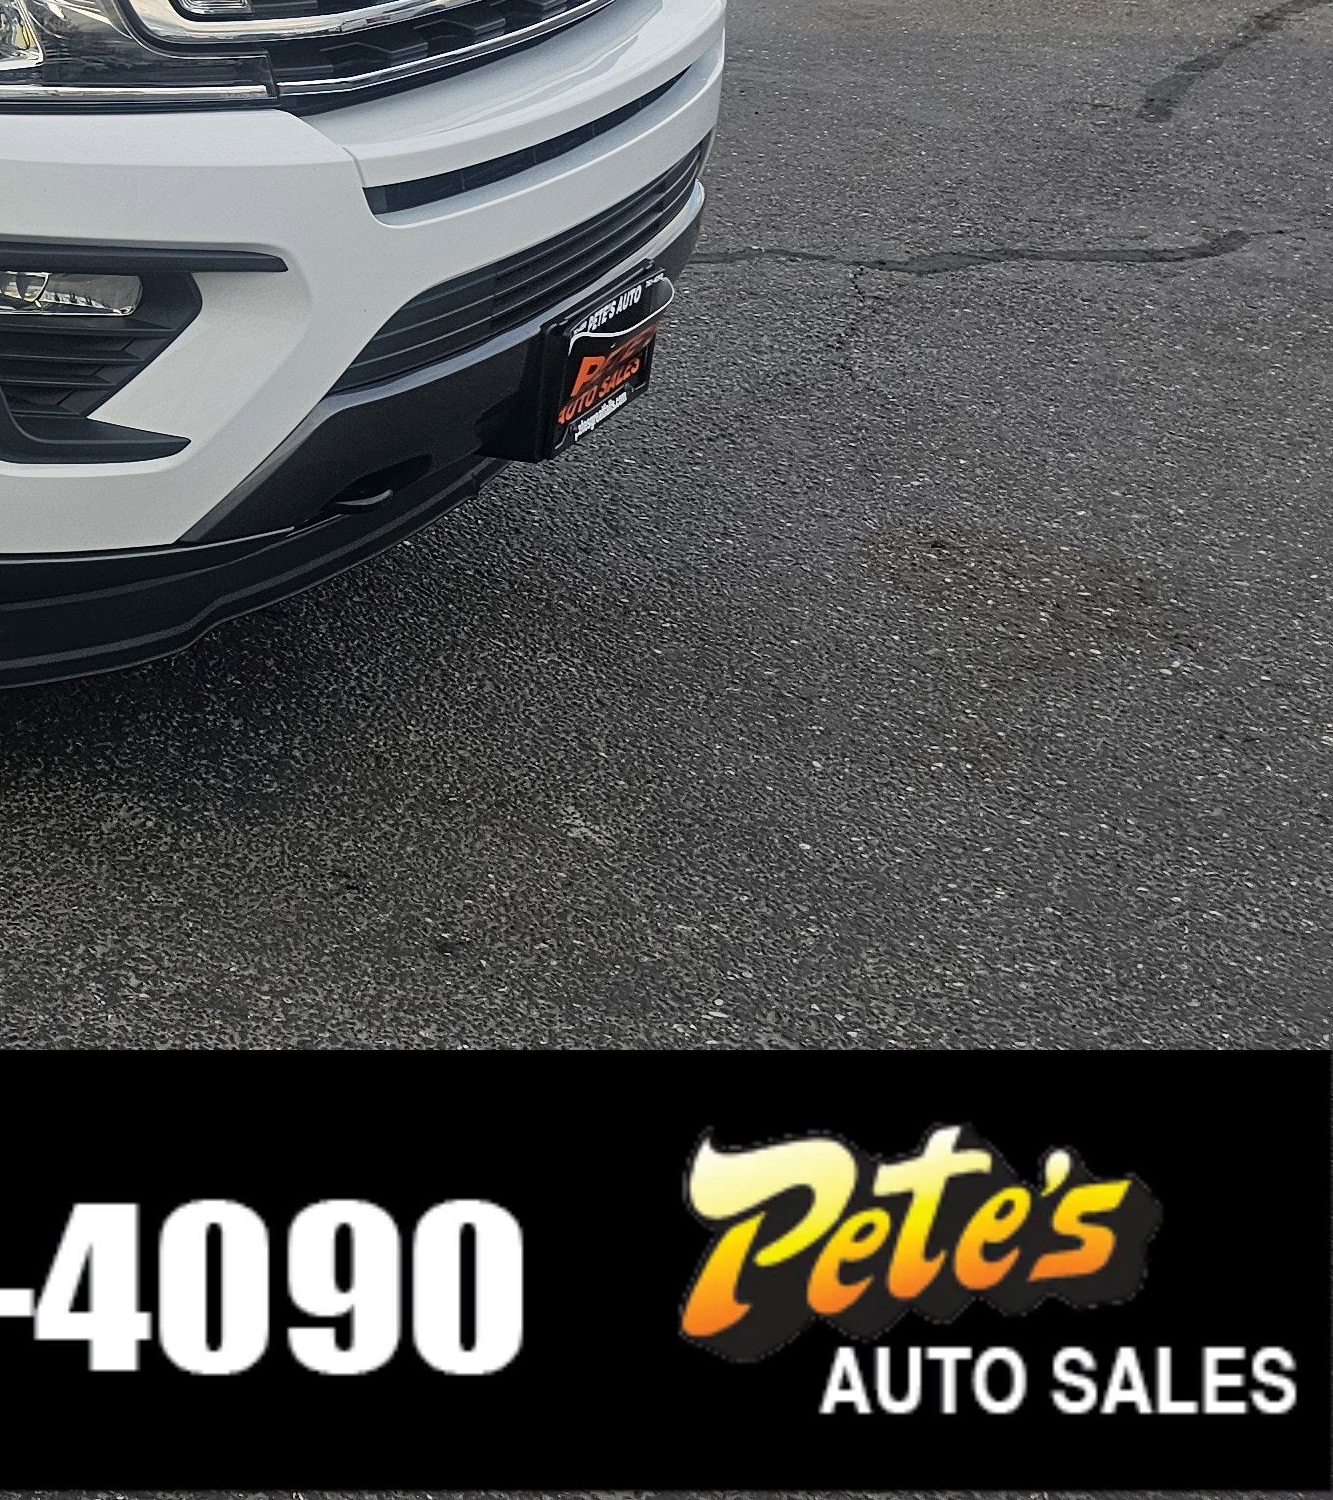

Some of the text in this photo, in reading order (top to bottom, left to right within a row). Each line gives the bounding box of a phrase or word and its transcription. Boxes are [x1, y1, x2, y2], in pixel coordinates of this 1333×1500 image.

[587, 299, 617, 334] PETE'S
[616, 284, 642, 316] AUTO
[557, 385, 599, 425] AUTO
[598, 357, 642, 399] SALES
